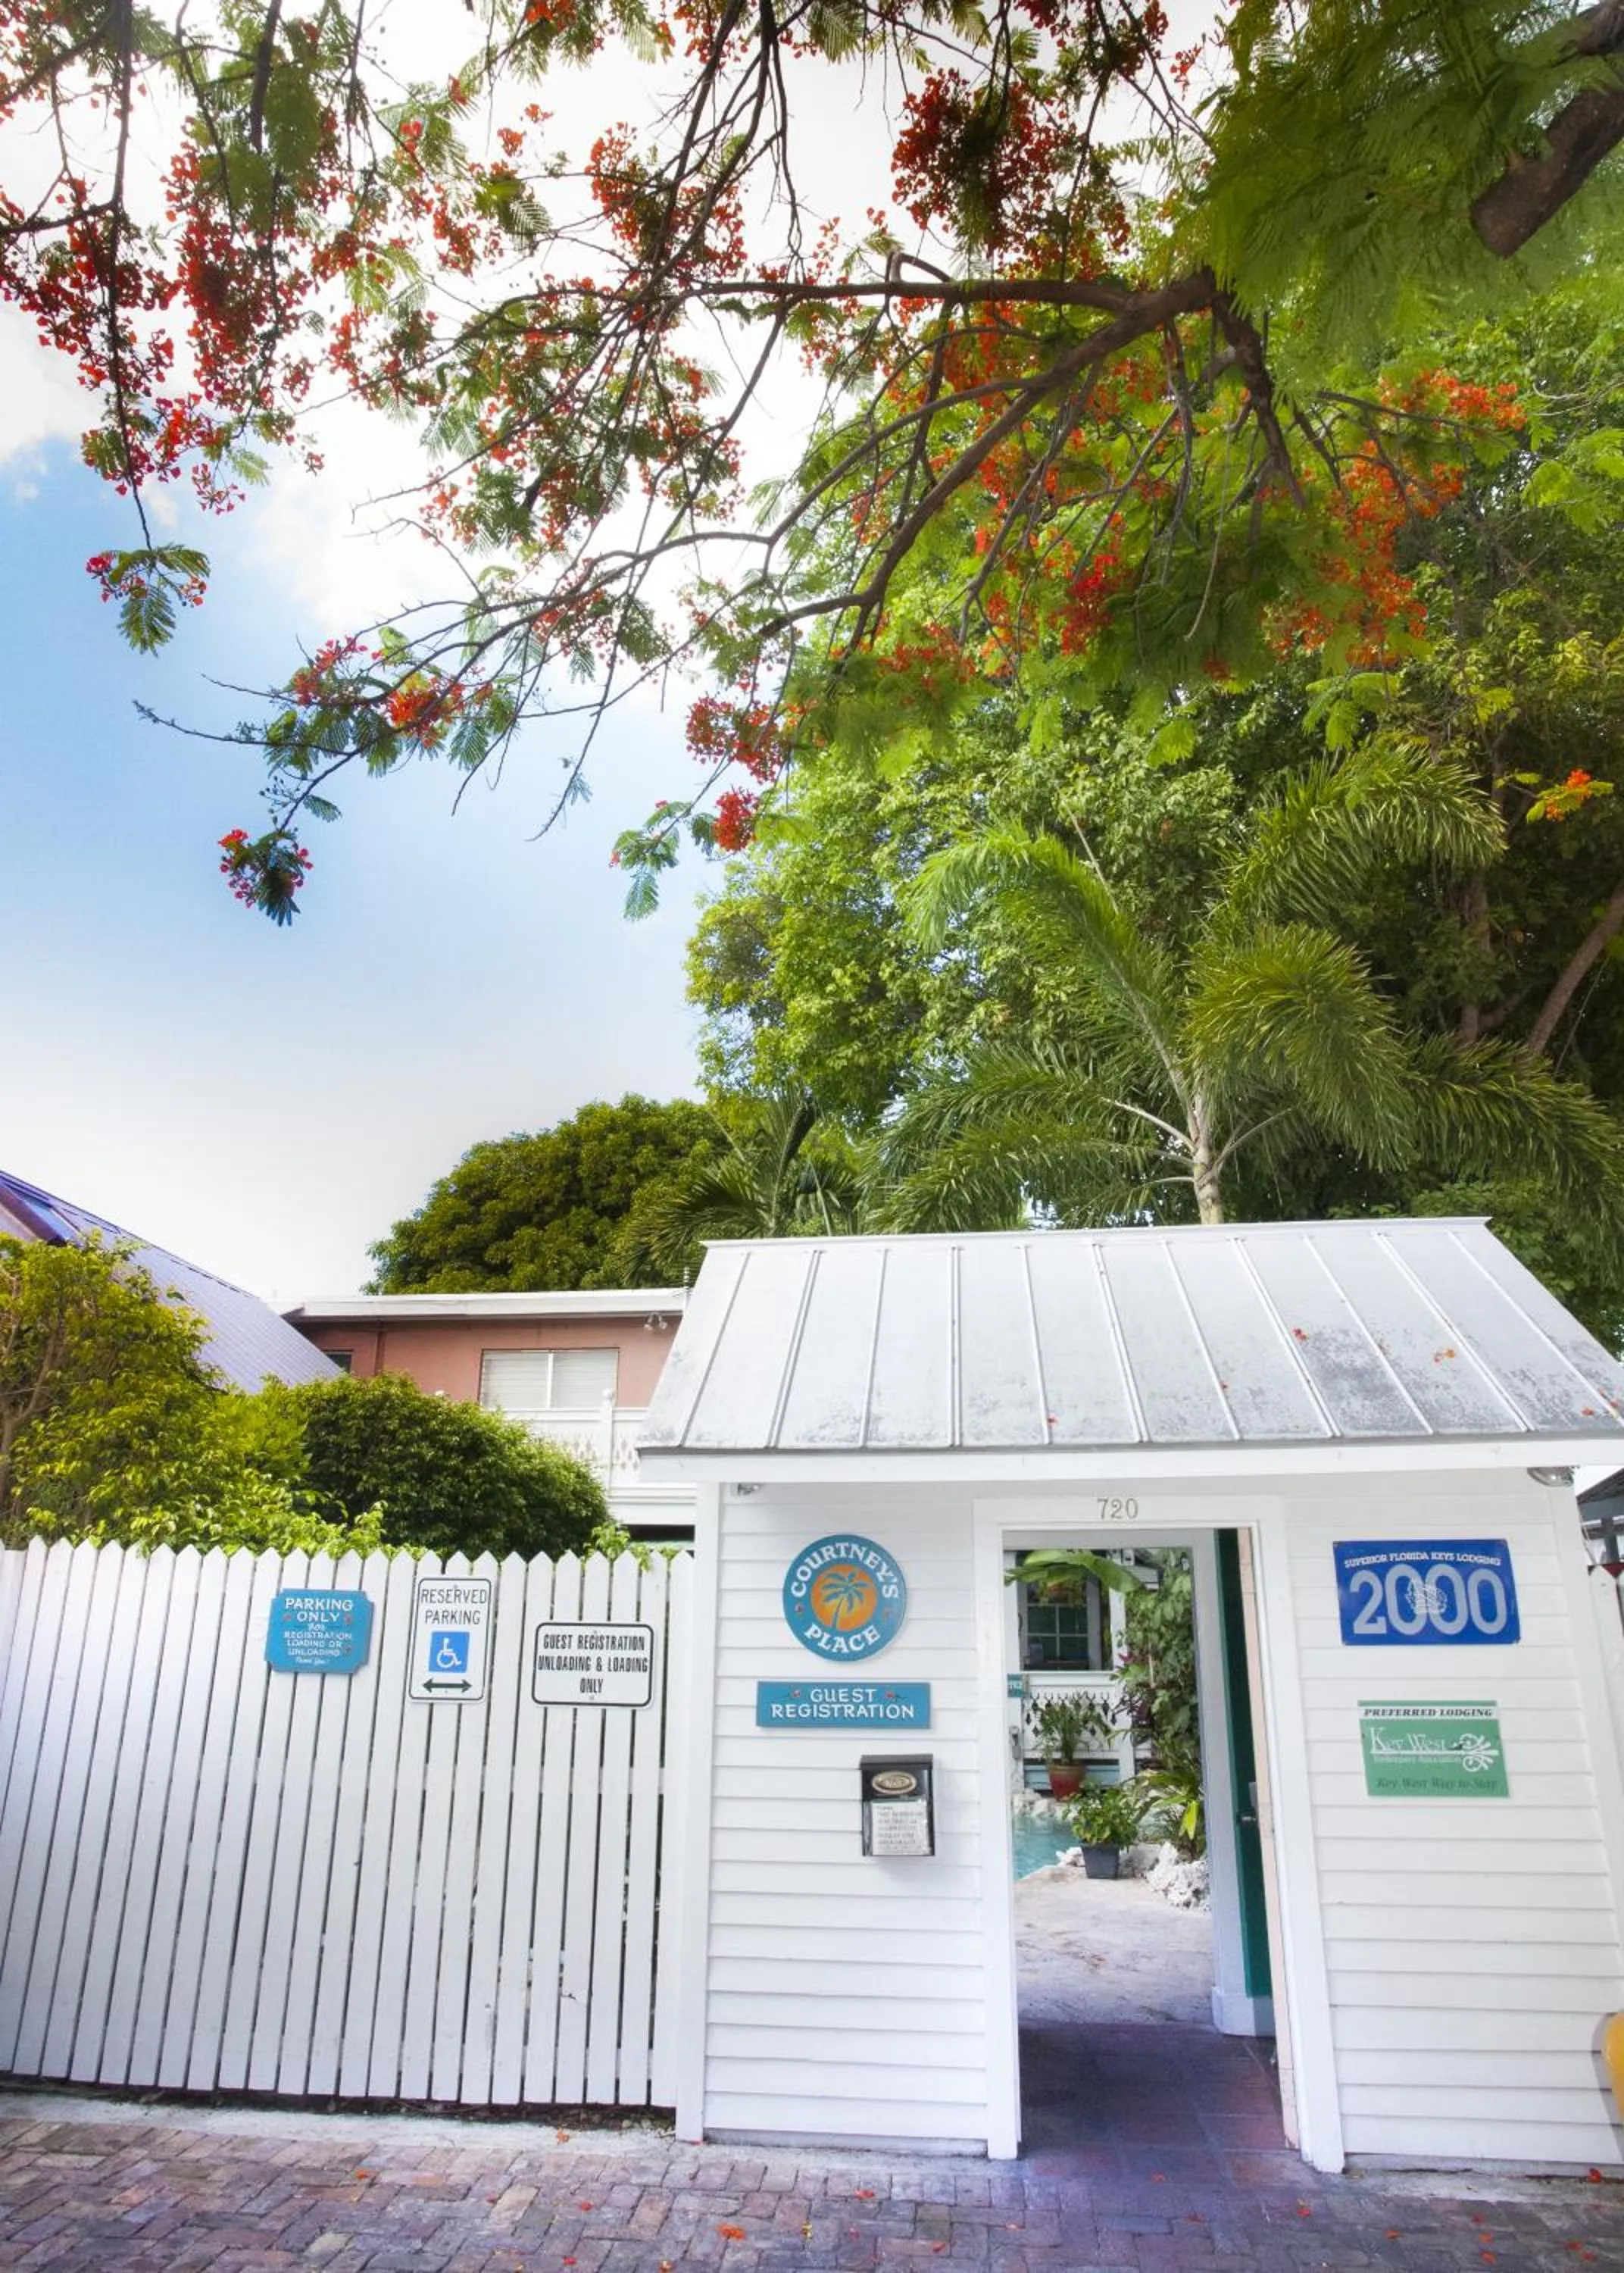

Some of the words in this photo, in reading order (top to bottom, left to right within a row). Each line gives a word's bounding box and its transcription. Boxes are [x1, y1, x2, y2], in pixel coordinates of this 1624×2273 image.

[1097, 1497, 1138, 1519] 720
[1344, 1554, 1388, 1568] SUPERIOR
[1390, 1552, 1429, 1562] FLORIDA
[1431, 1552, 1455, 1561] KEYS
[1456, 1552, 1502, 1567] LODGING
[791, 1542, 900, 1598] COURTNEY'S
[420, 1588, 487, 1604] RESERVED
[1349, 1563, 1507, 1635] 2000
[285, 1597, 354, 1612] PARKING
[296, 1611, 340, 1622] ONLY
[425, 1609, 481, 1625] PARKING
[284, 1631, 352, 1640] REGISTRATION
[286, 1639, 326, 1648] LOADING
[543, 1634, 573, 1649] GUEST
[577, 1634, 645, 1650] REGISTRATION
[804, 1622, 881, 1653] PLACE
[288, 1648, 340, 1657] UNLOADING
[538, 1656, 592, 1671] UNLOADING
[596, 1656, 603, 1672] &
[607, 1657, 648, 1673] LOADING
[579, 1677, 604, 1693] ONLY
[810, 1687, 877, 1702] GUEST
[771, 1703, 914, 1719] REGISTRATION
[1363, 1709, 1437, 1717] PREFERRED
[1439, 1709, 1493, 1717] LODGING
